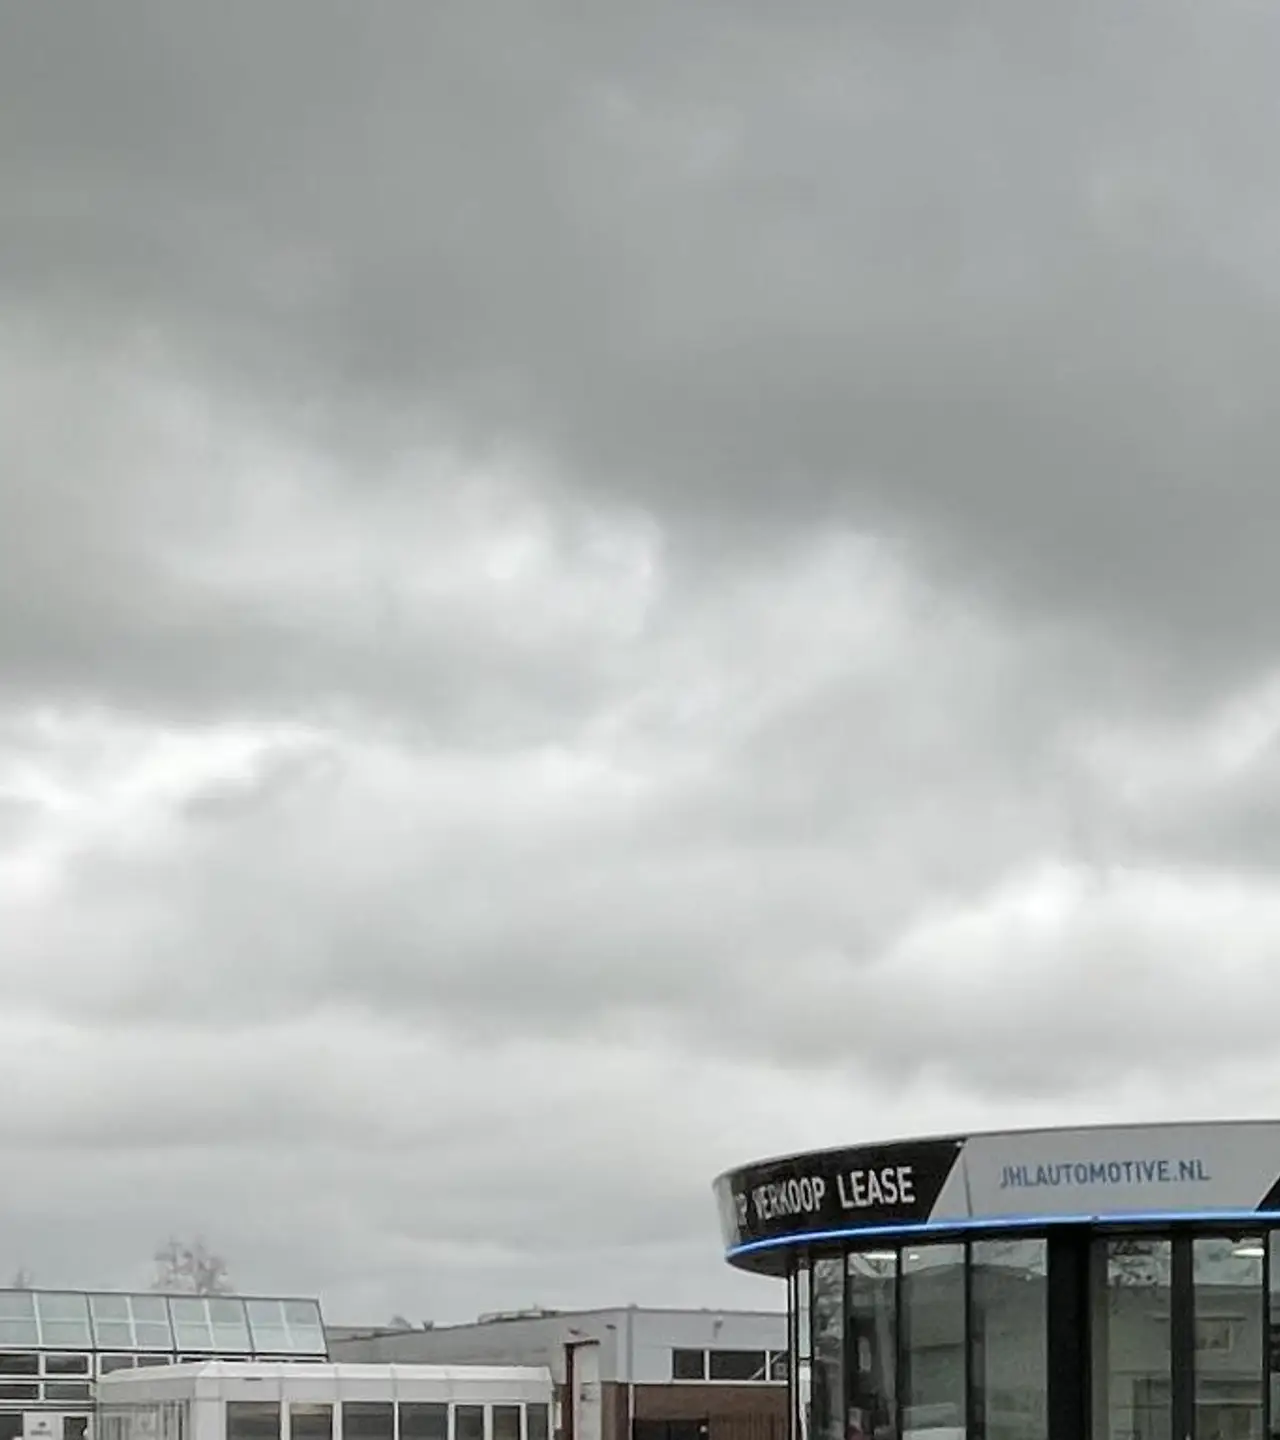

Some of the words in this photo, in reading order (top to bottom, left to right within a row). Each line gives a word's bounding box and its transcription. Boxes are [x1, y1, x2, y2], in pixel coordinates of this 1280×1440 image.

[752, 1176, 825, 1220] VERKOOP
[836, 1166, 916, 1209] LEASE
[1000, 1159, 1211, 1189] JHLAUTOMOTIVE.NL
